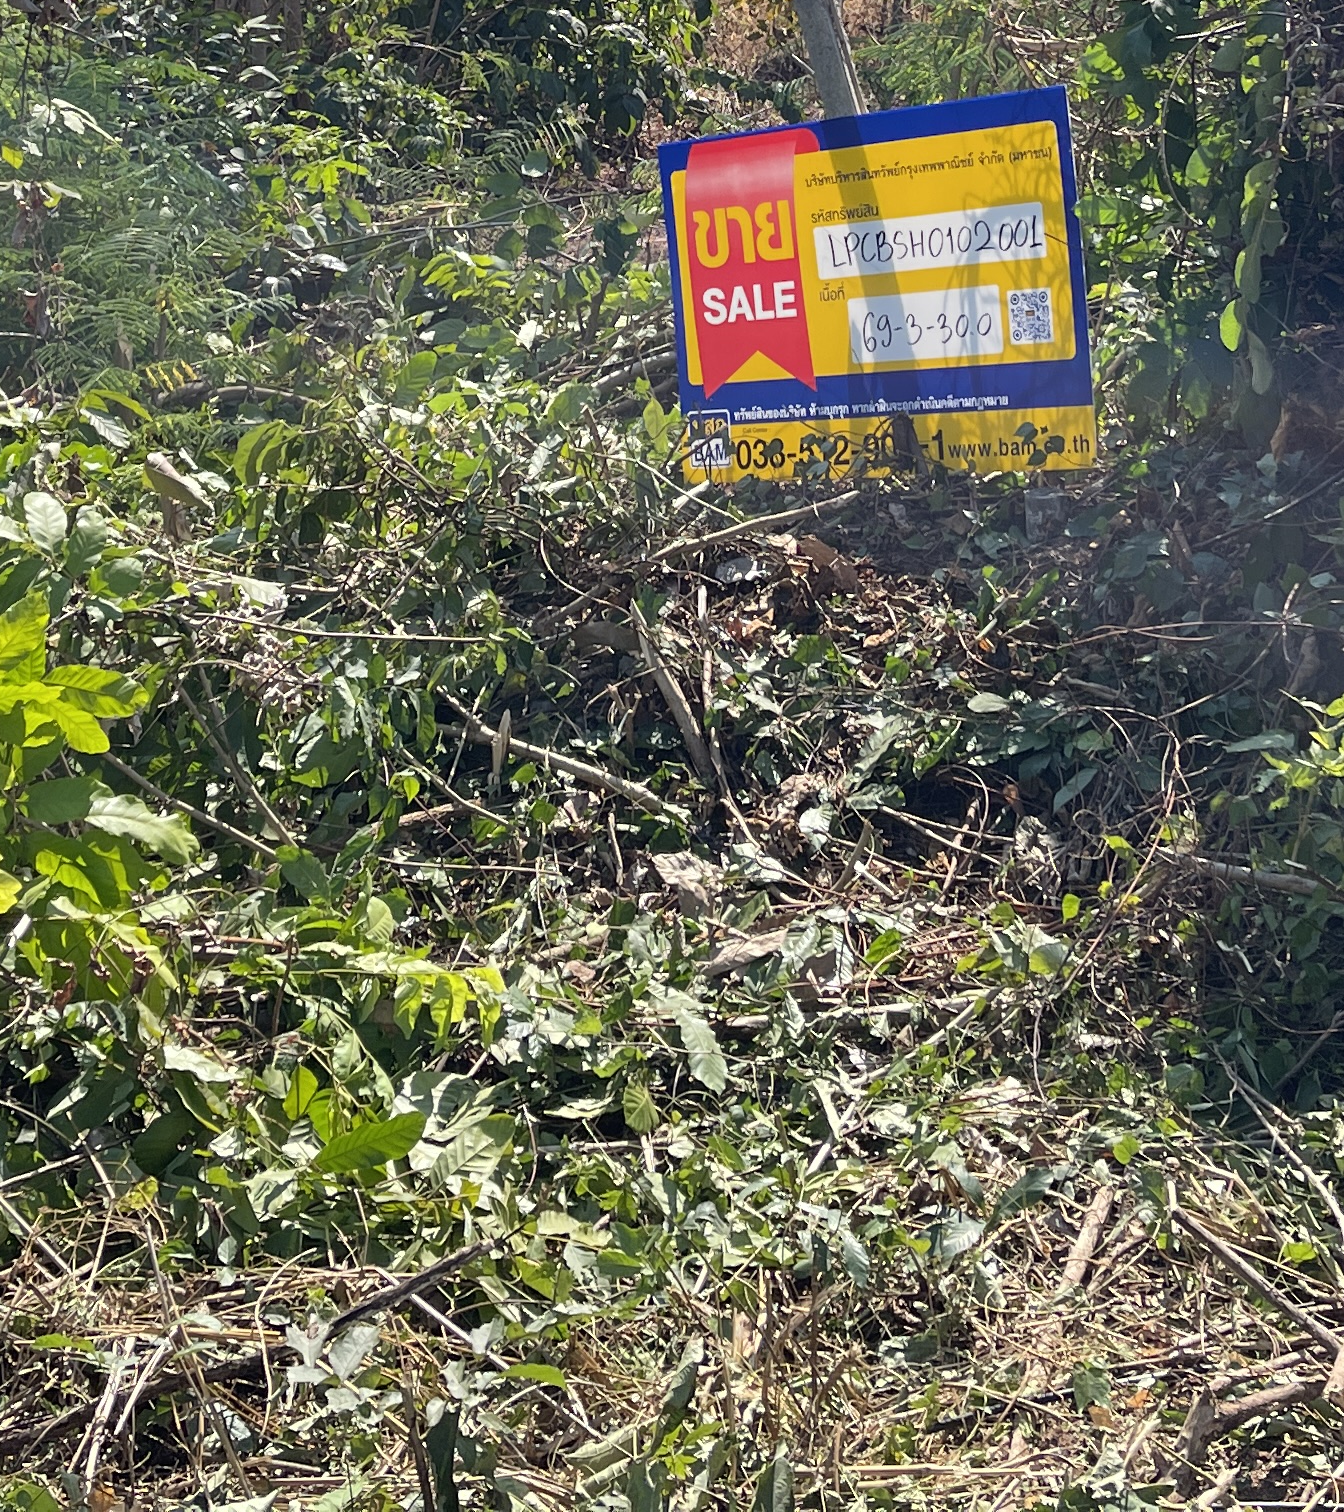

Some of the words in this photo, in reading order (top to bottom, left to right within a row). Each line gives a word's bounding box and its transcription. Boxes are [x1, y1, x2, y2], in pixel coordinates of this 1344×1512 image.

[978, 150, 1006, 166] จำกัด
[1008, 146, 1053, 164] (มหาชน)
[810, 203, 880, 224] รหัสทรัพย์สิน
[693, 200, 794, 268] ขาย
[702, 280, 798, 325] SALE
[818, 282, 846, 302] เนื้อที่
